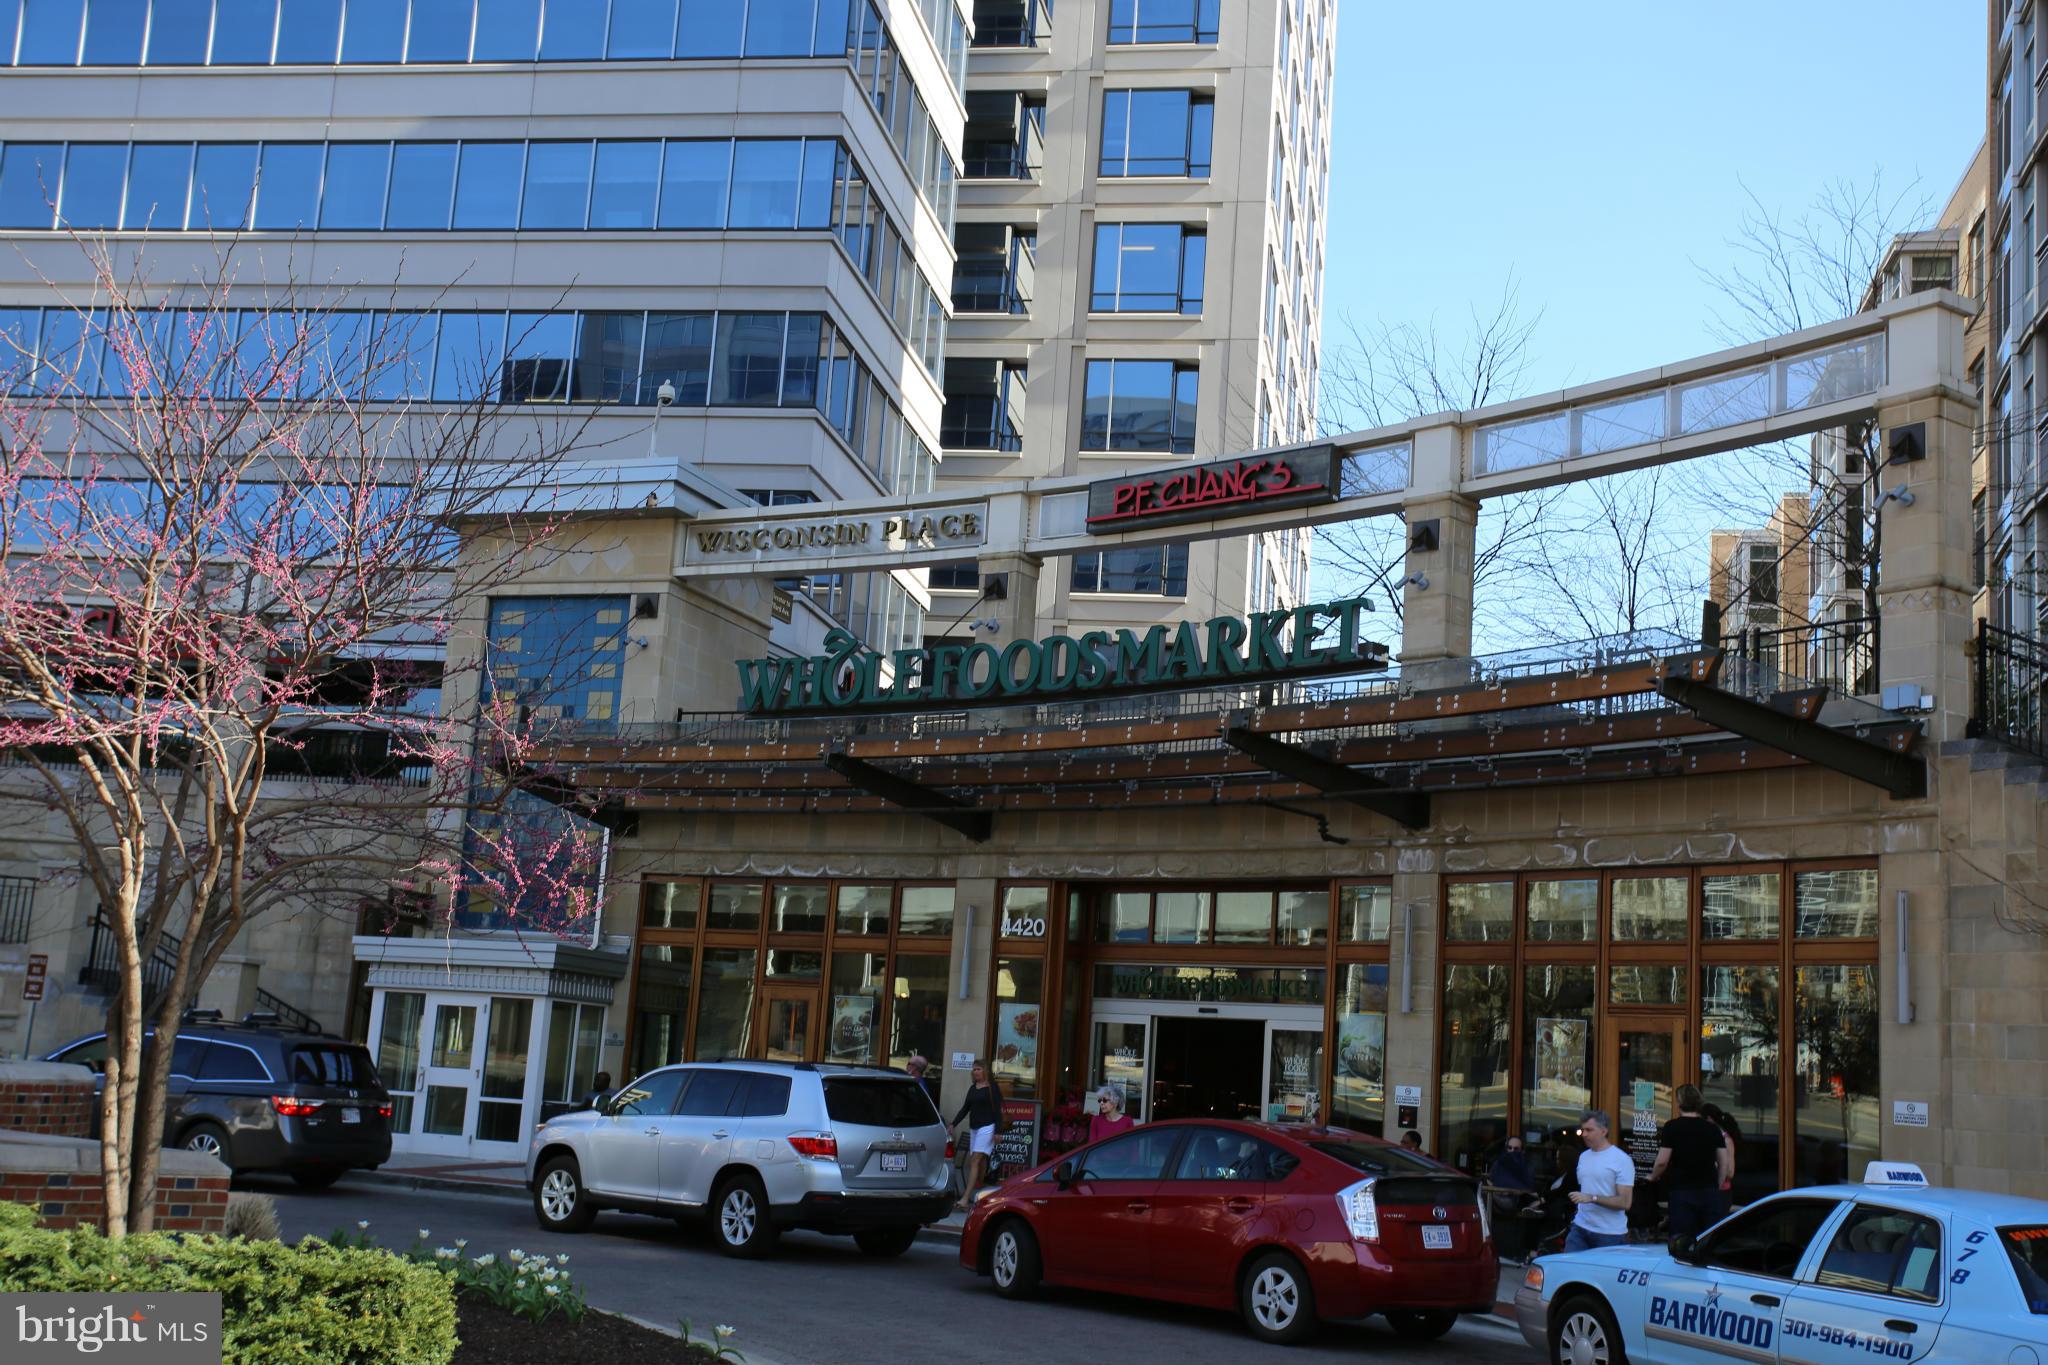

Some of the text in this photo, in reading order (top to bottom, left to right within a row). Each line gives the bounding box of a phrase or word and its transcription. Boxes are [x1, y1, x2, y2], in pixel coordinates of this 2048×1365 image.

[1159, 460, 1293, 507] CHANG'S
[697, 512, 980, 553] WISCONSIN PLACE
[1001, 918, 1046, 937] 4420
[1887, 1171, 1923, 1182] BARWOOD
[1617, 1269, 1649, 1286] 678
[1650, 1296, 1773, 1349] BARWOOD
[1782, 1318, 1914, 1360] 301-984-1900
